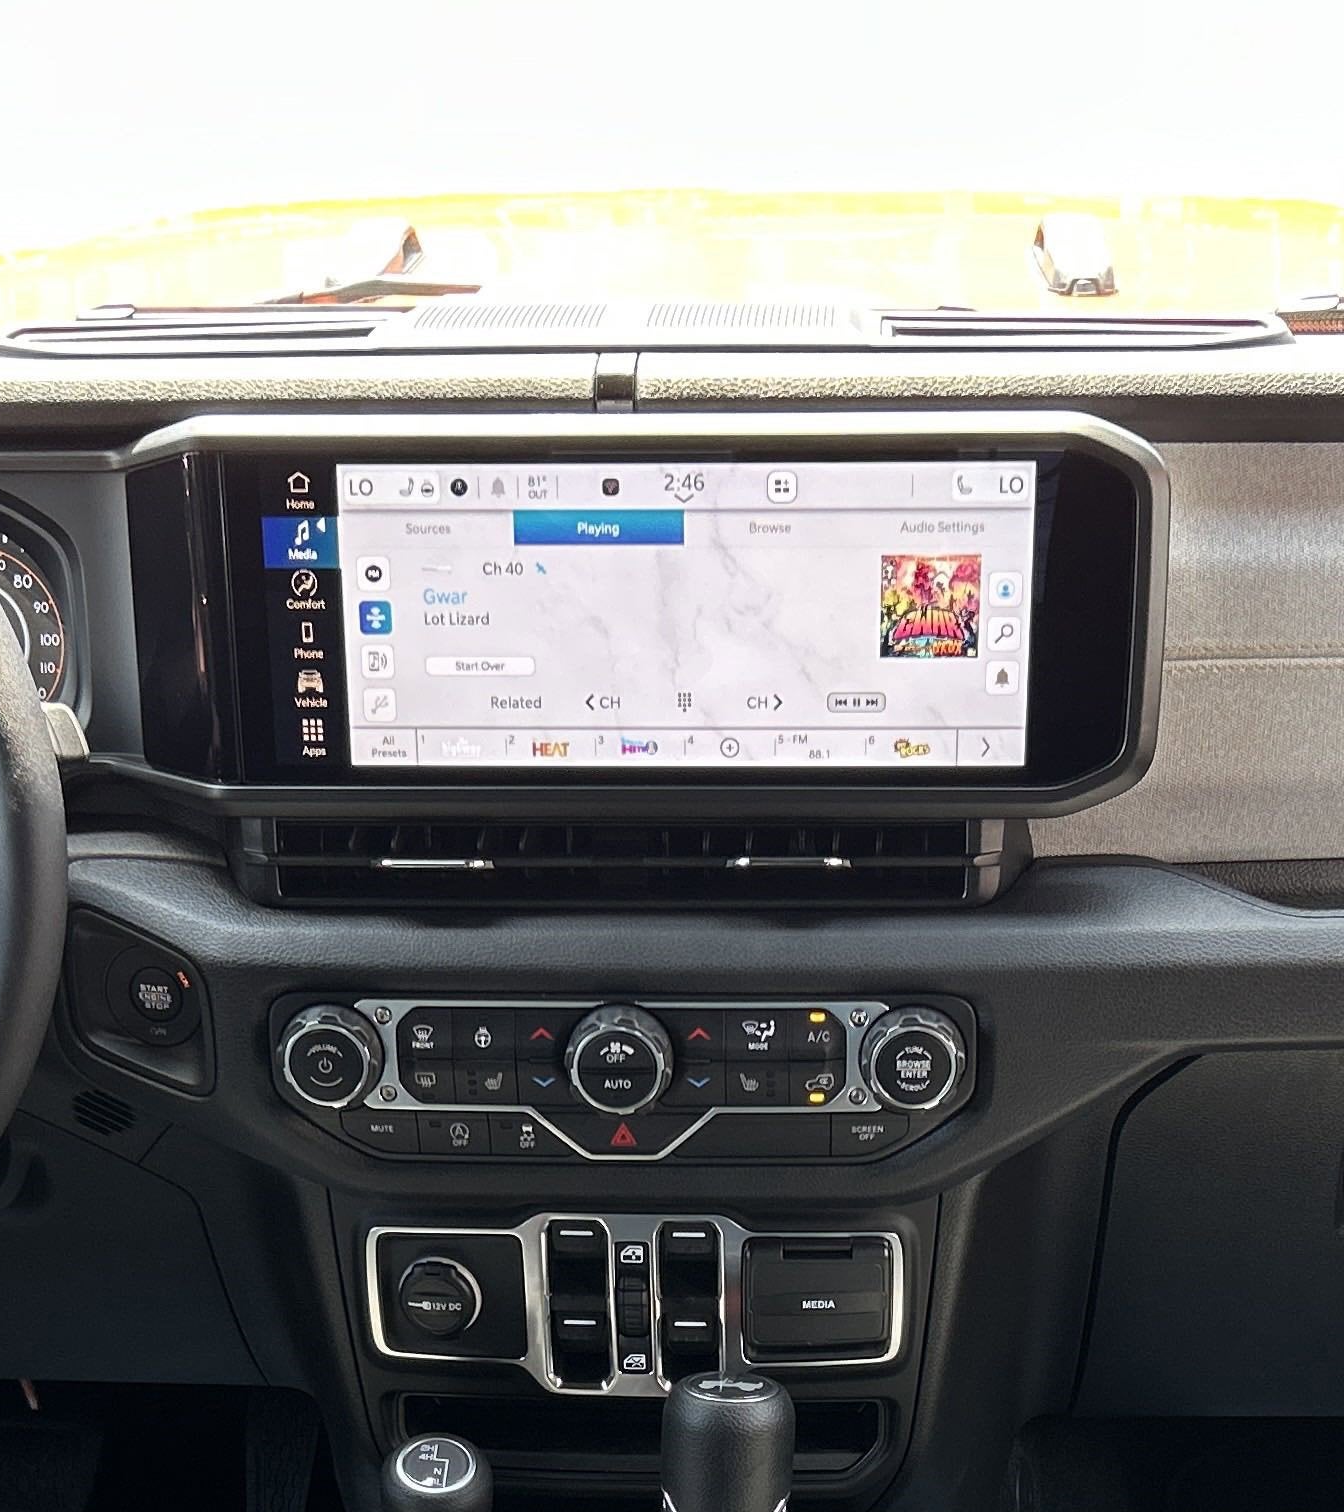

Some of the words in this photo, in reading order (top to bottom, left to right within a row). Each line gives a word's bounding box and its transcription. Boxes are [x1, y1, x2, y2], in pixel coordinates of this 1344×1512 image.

[348, 478, 374, 497] LO
[664, 473, 705, 492] 2:46
[999, 476, 1025, 494] LO
[528, 489, 548, 500] OUT
[286, 498, 315, 510] Home
[405, 522, 451, 535] Sources
[577, 521, 620, 538] Playing
[749, 522, 792, 534] Browse
[900, 521, 936, 534] Audio
[938, 521, 985, 536] Settings
[288, 548, 318, 561] Media
[482, 562, 503, 576] Ch
[505, 562, 524, 576] 40
[13, 574, 32, 590] 80
[422, 588, 468, 605] Gwar
[33, 601, 50, 615] 90
[286, 598, 326, 610] Comfort
[423, 612, 446, 626] Lot
[449, 612, 490, 626] Lizard
[40, 633, 59, 646] 100
[294, 647, 324, 660] Phone
[40, 662, 56, 674] 110
[455, 661, 478, 672] Start
[481, 661, 505, 672] Over
[294, 697, 328, 708] Vehicle
[490, 696, 542, 709] Related
[599, 696, 621, 710] CH
[746, 696, 768, 710] CH
[382, 736, 395, 746] All
[302, 746, 326, 758] Apps
[371, 748, 408, 759] Presets
[532, 742, 570, 758] HEAT
[808, 750, 831, 760] 88.1
[139, 983, 169, 993] START
[144, 1002, 170, 1010] STOP
[807, 1032, 831, 1044] A/C
[748, 1041, 769, 1051] MODE
[606, 1053, 626, 1064] OFF
[896, 1059, 931, 1069] BROWSE
[900, 1070, 928, 1079] ENTER
[604, 1080, 632, 1090] AUTO
[370, 1124, 394, 1134] MUTE
[852, 1125, 885, 1134] SCREEN
[452, 1139, 469, 1147] OFF
[859, 1133, 875, 1142] OFF
[520, 1141, 536, 1149] OFF
[432, 1302, 447, 1311] 12V
[448, 1302, 462, 1311] DC
[802, 1299, 836, 1309] MEDIA
[419, 1453, 433, 1461] 4H
[434, 1467, 442, 1475] N
